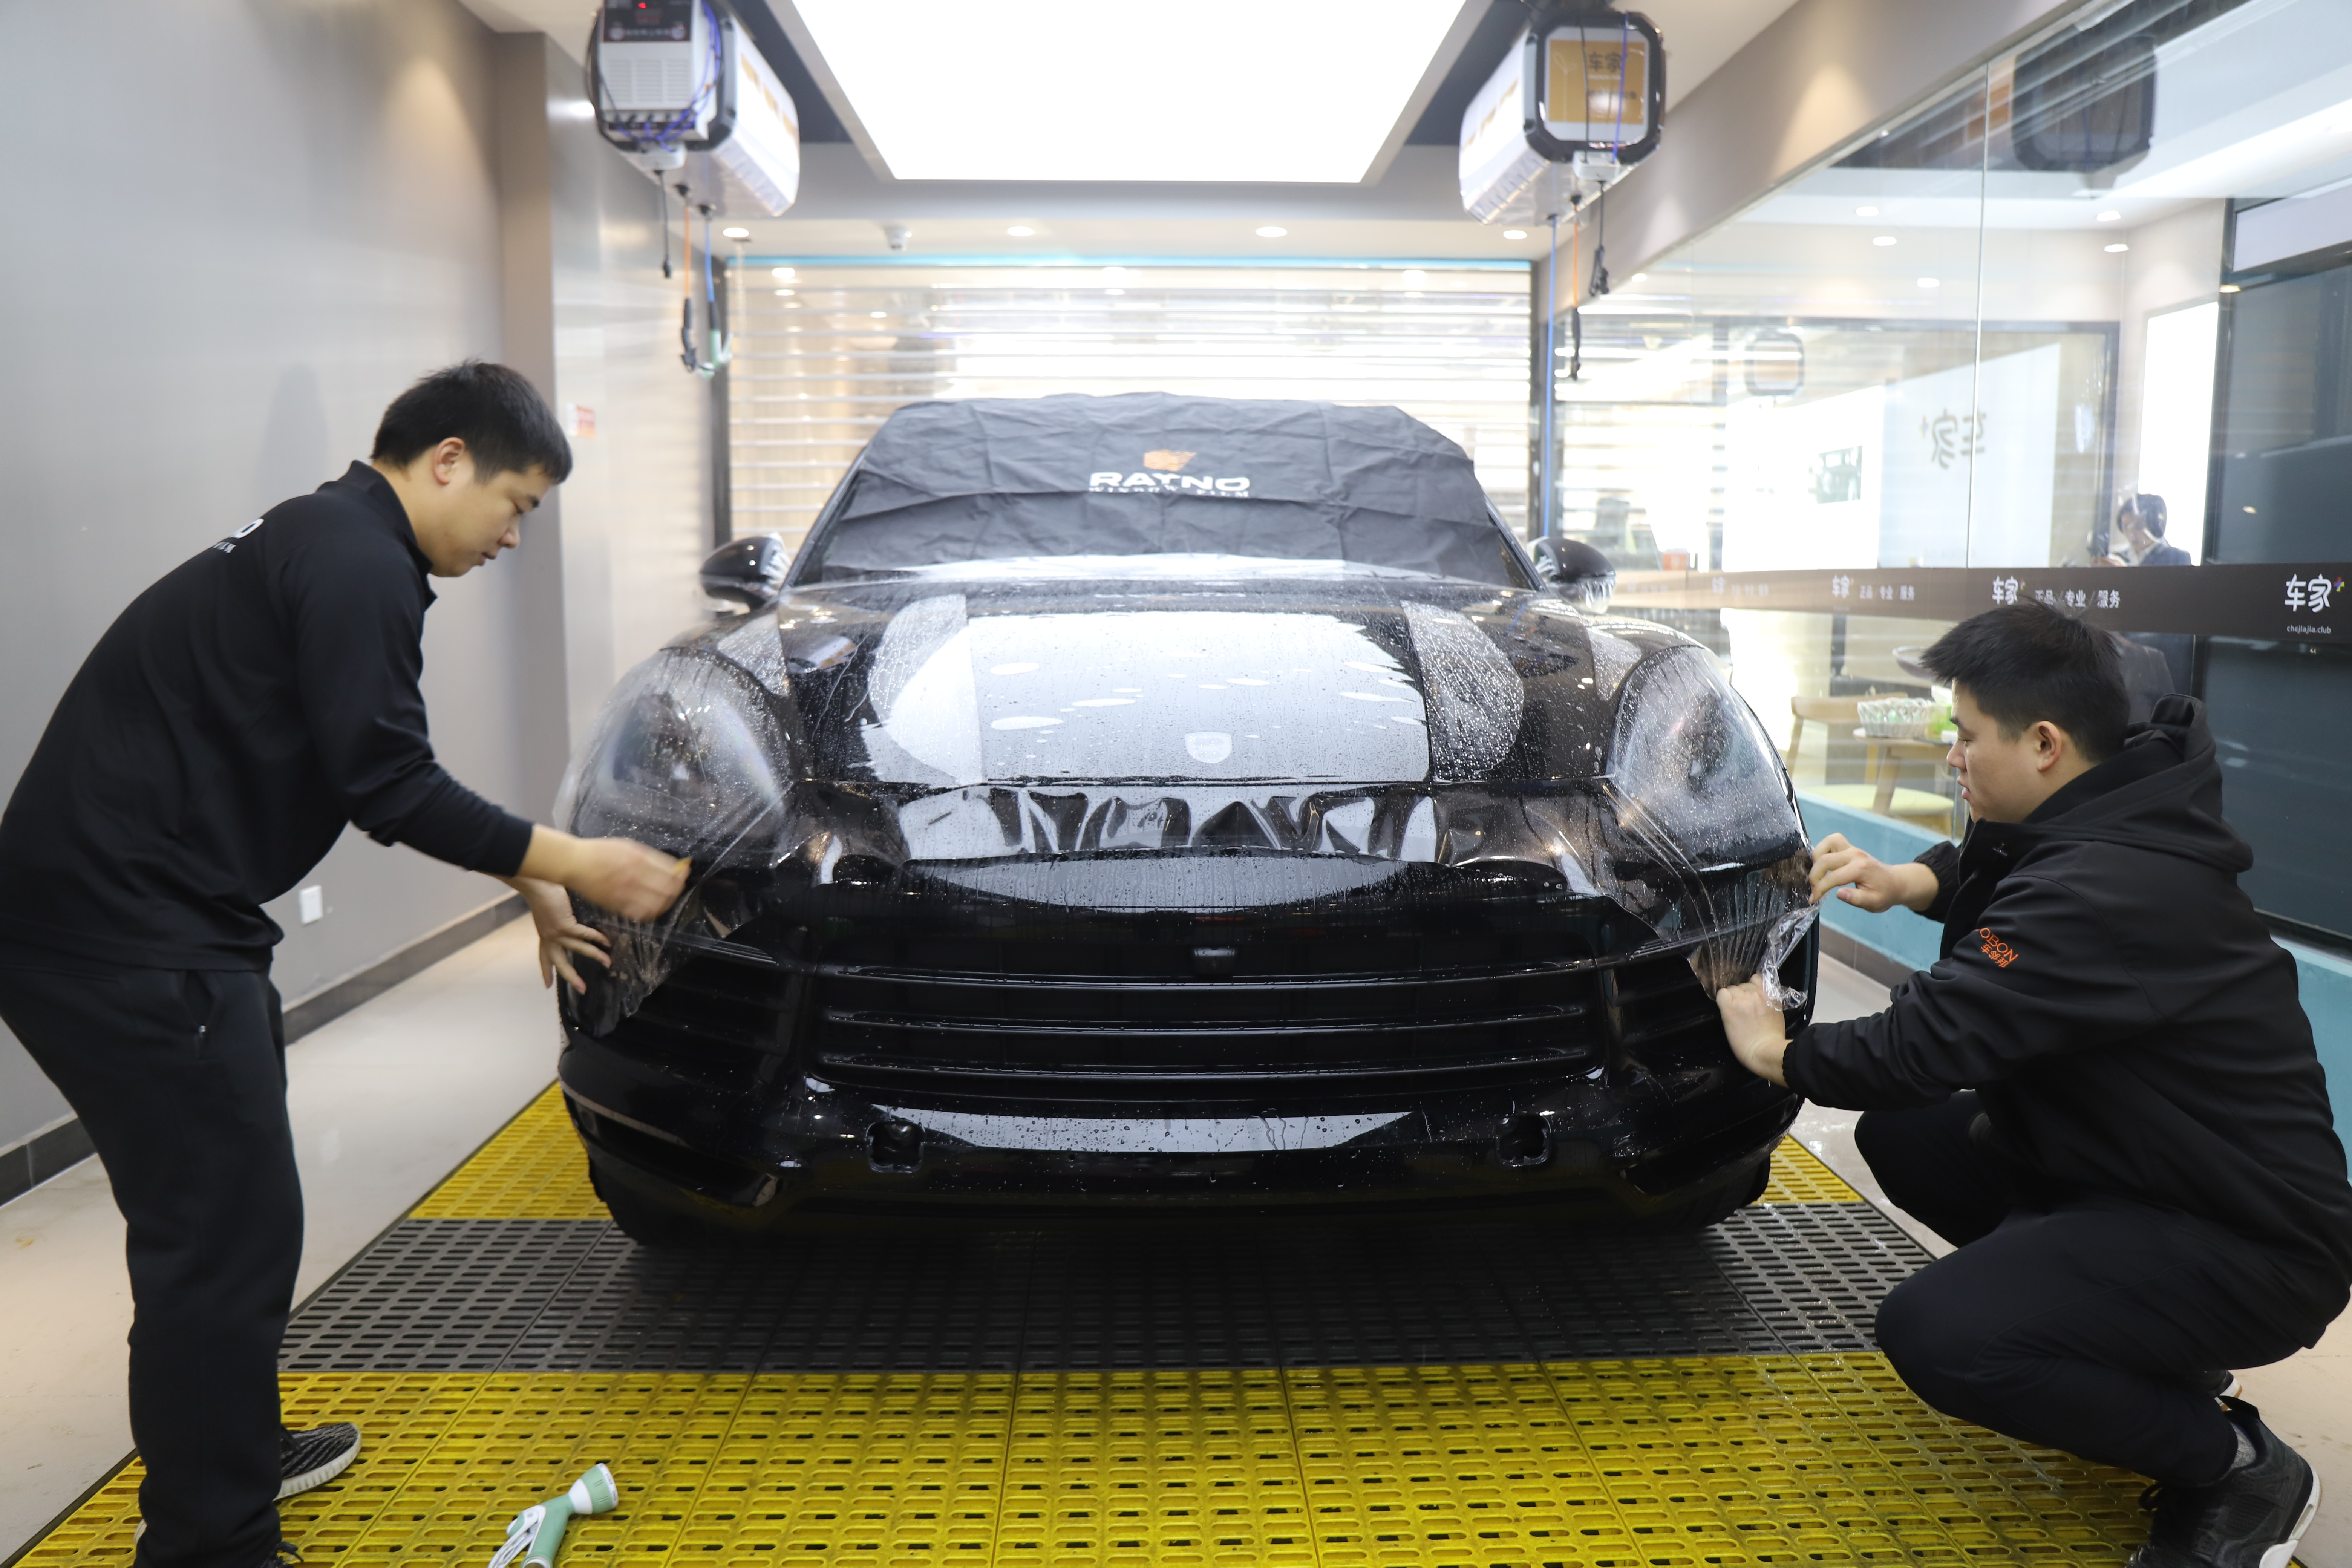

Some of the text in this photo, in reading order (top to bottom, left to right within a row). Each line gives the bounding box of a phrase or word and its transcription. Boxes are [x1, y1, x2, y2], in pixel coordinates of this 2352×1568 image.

[1089, 472, 1250, 491] RAYNO
[1992, 575, 2019, 605] 车家
[2096, 589, 2120, 608] 服务
[2284, 573, 2332, 613] 车家
[2286, 624, 2331, 635] chejiajia.club
